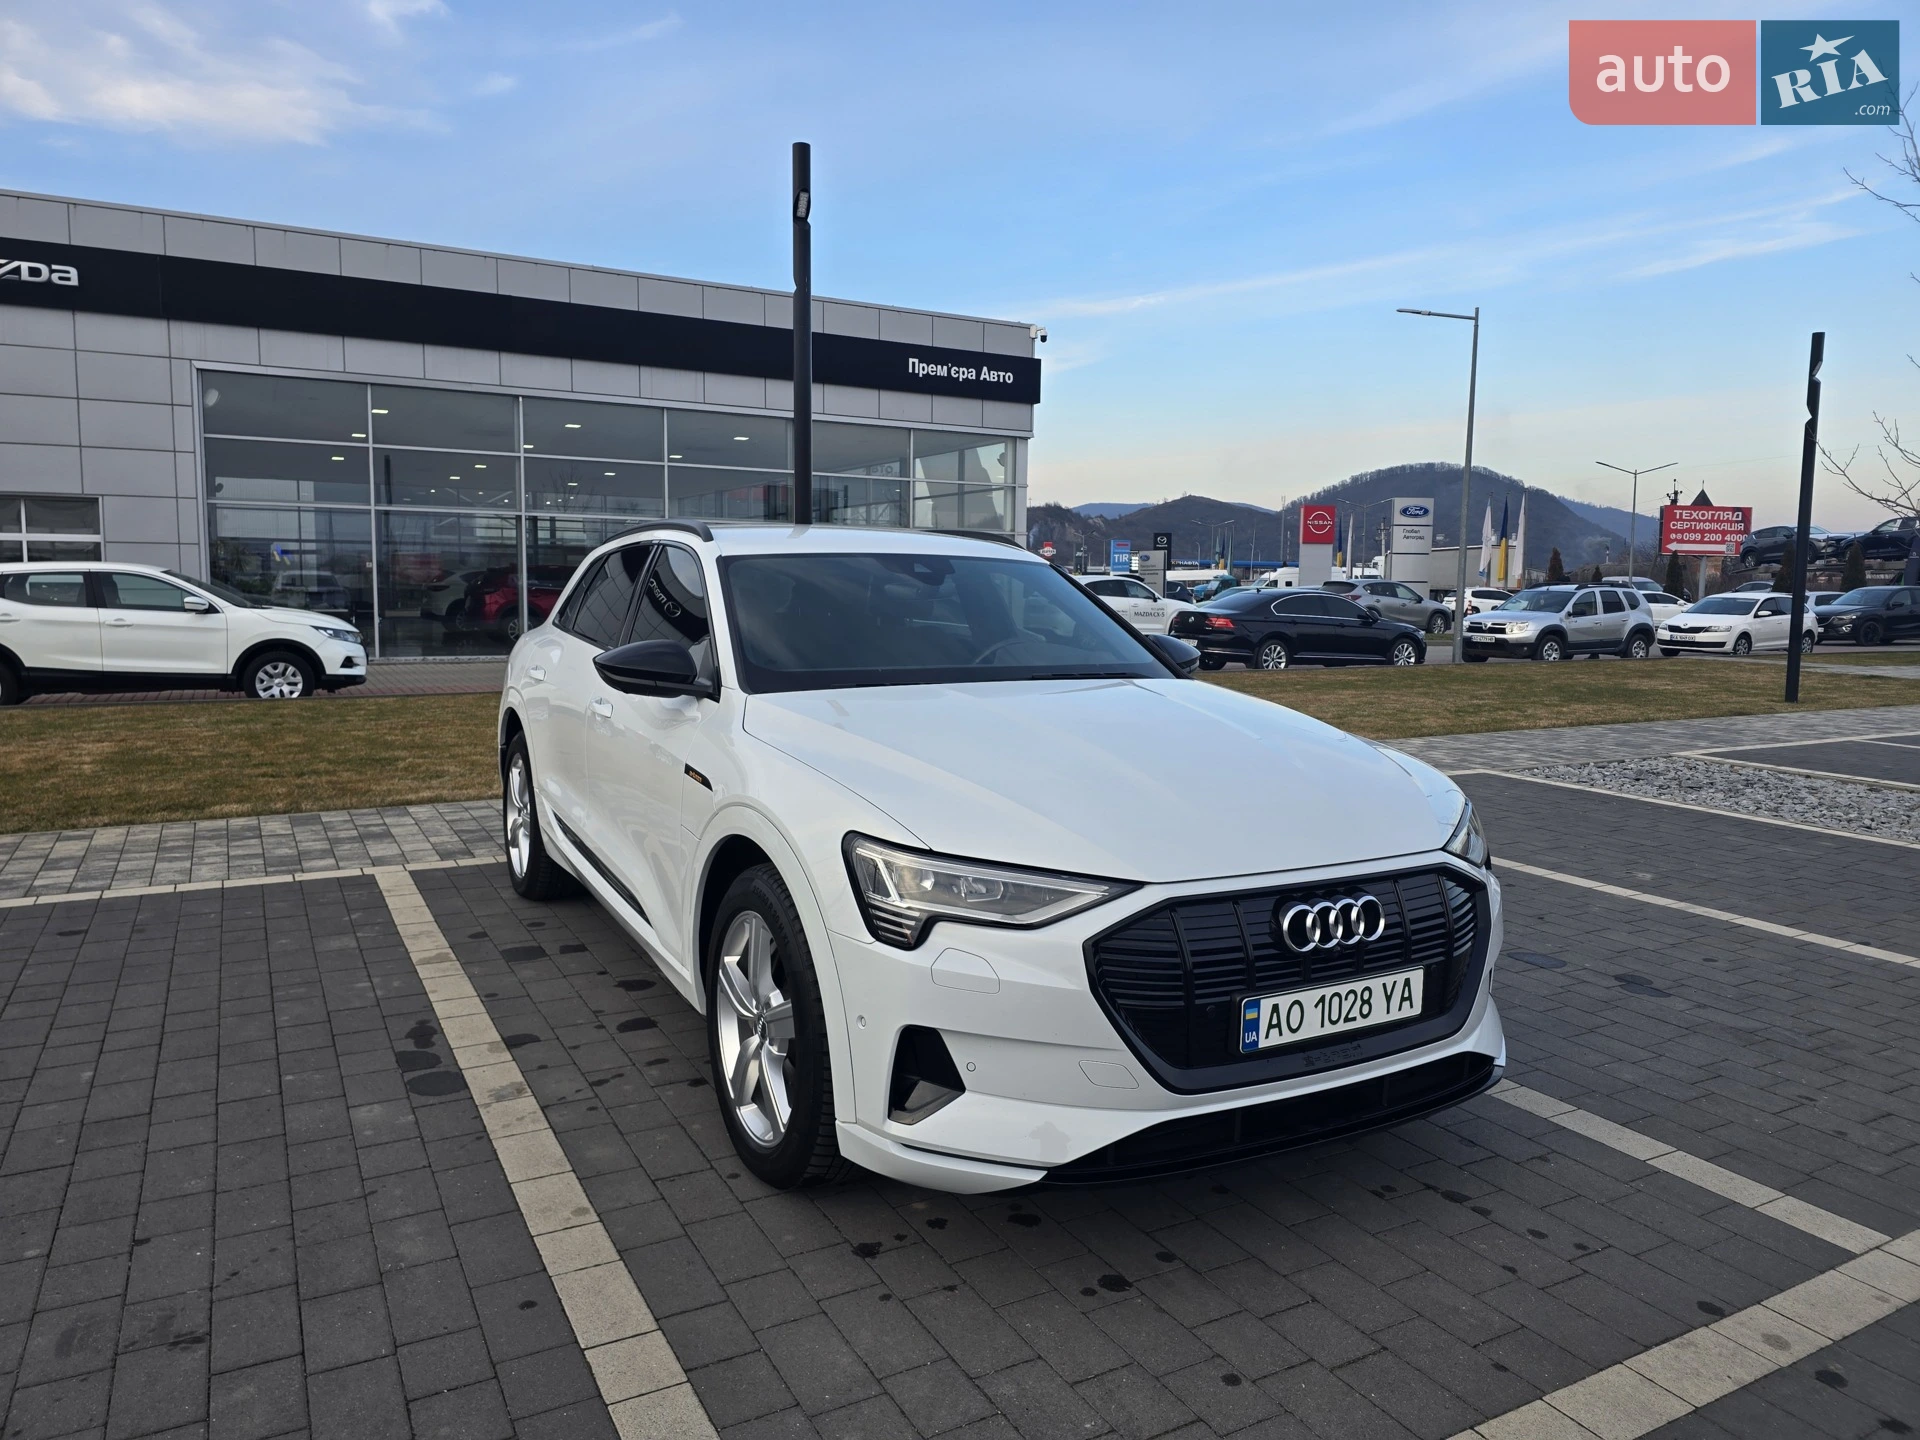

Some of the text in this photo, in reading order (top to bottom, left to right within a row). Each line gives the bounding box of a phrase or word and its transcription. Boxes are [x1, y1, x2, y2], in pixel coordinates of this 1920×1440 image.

[908, 358, 1014, 384] Прем'єра Авто
[1406, 506, 1424, 515] Ford
[1673, 510, 1742, 521] ТЕХОГЛЯД
[1670, 521, 1744, 531] СЕРТИФІКАЦІЯ
[1683, 533, 1701, 541] 099
[1704, 533, 1722, 541] 200
[1113, 554, 1129, 563] TIR
[1265, 977, 1414, 1040] AO 1028 YA
[1245, 1031, 1257, 1043] UA
